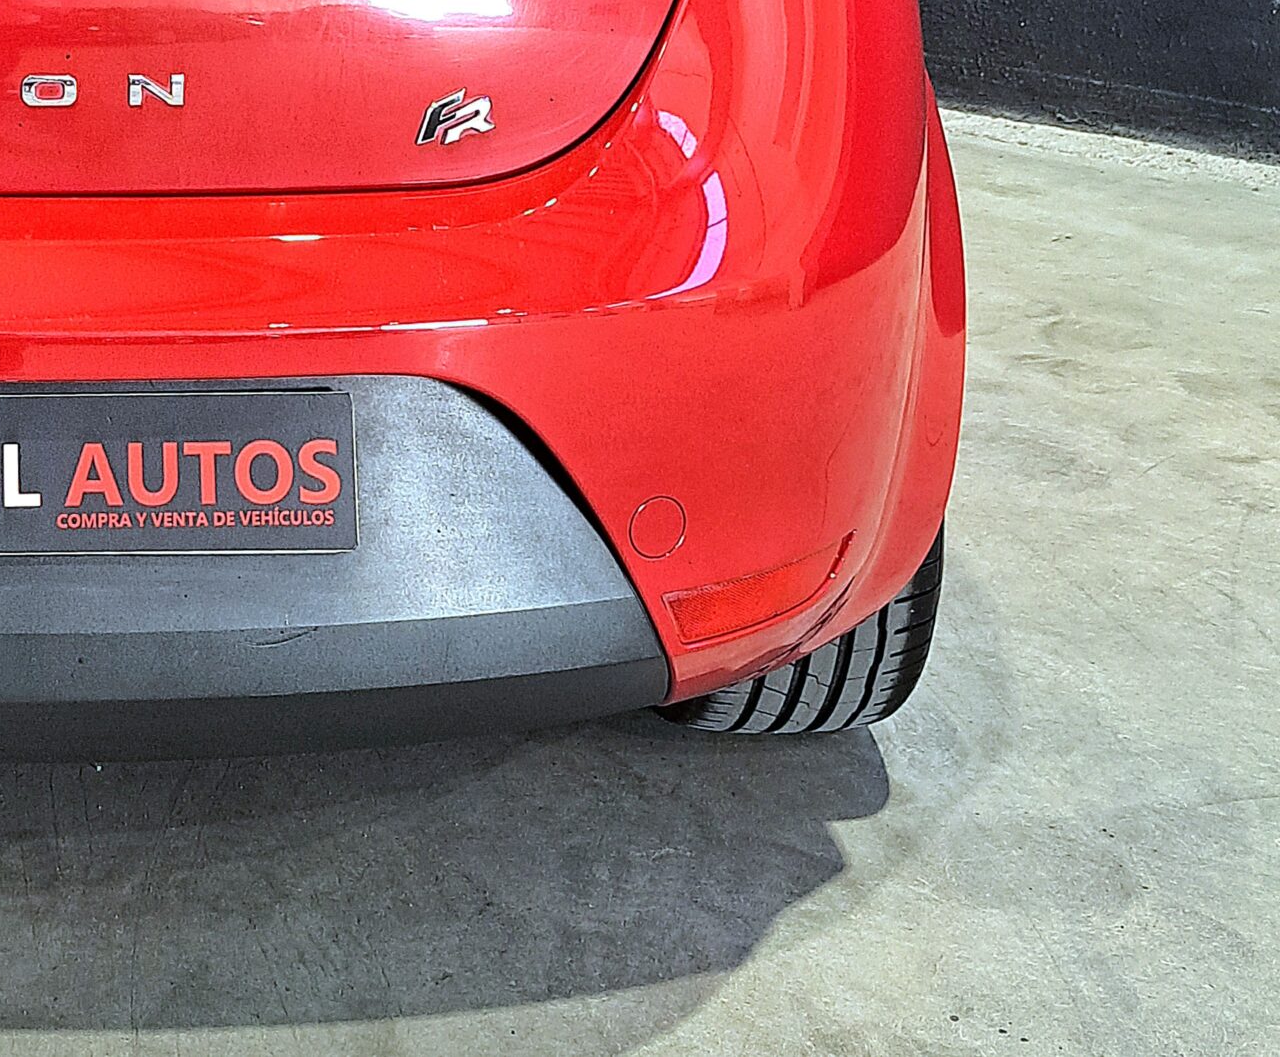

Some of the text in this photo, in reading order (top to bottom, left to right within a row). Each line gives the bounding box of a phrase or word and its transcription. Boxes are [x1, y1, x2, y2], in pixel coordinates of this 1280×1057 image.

[63, 439, 342, 507] AUTOS
[56, 506, 334, 529] COMPRA Y VENTA DE VEHÍCULOS
